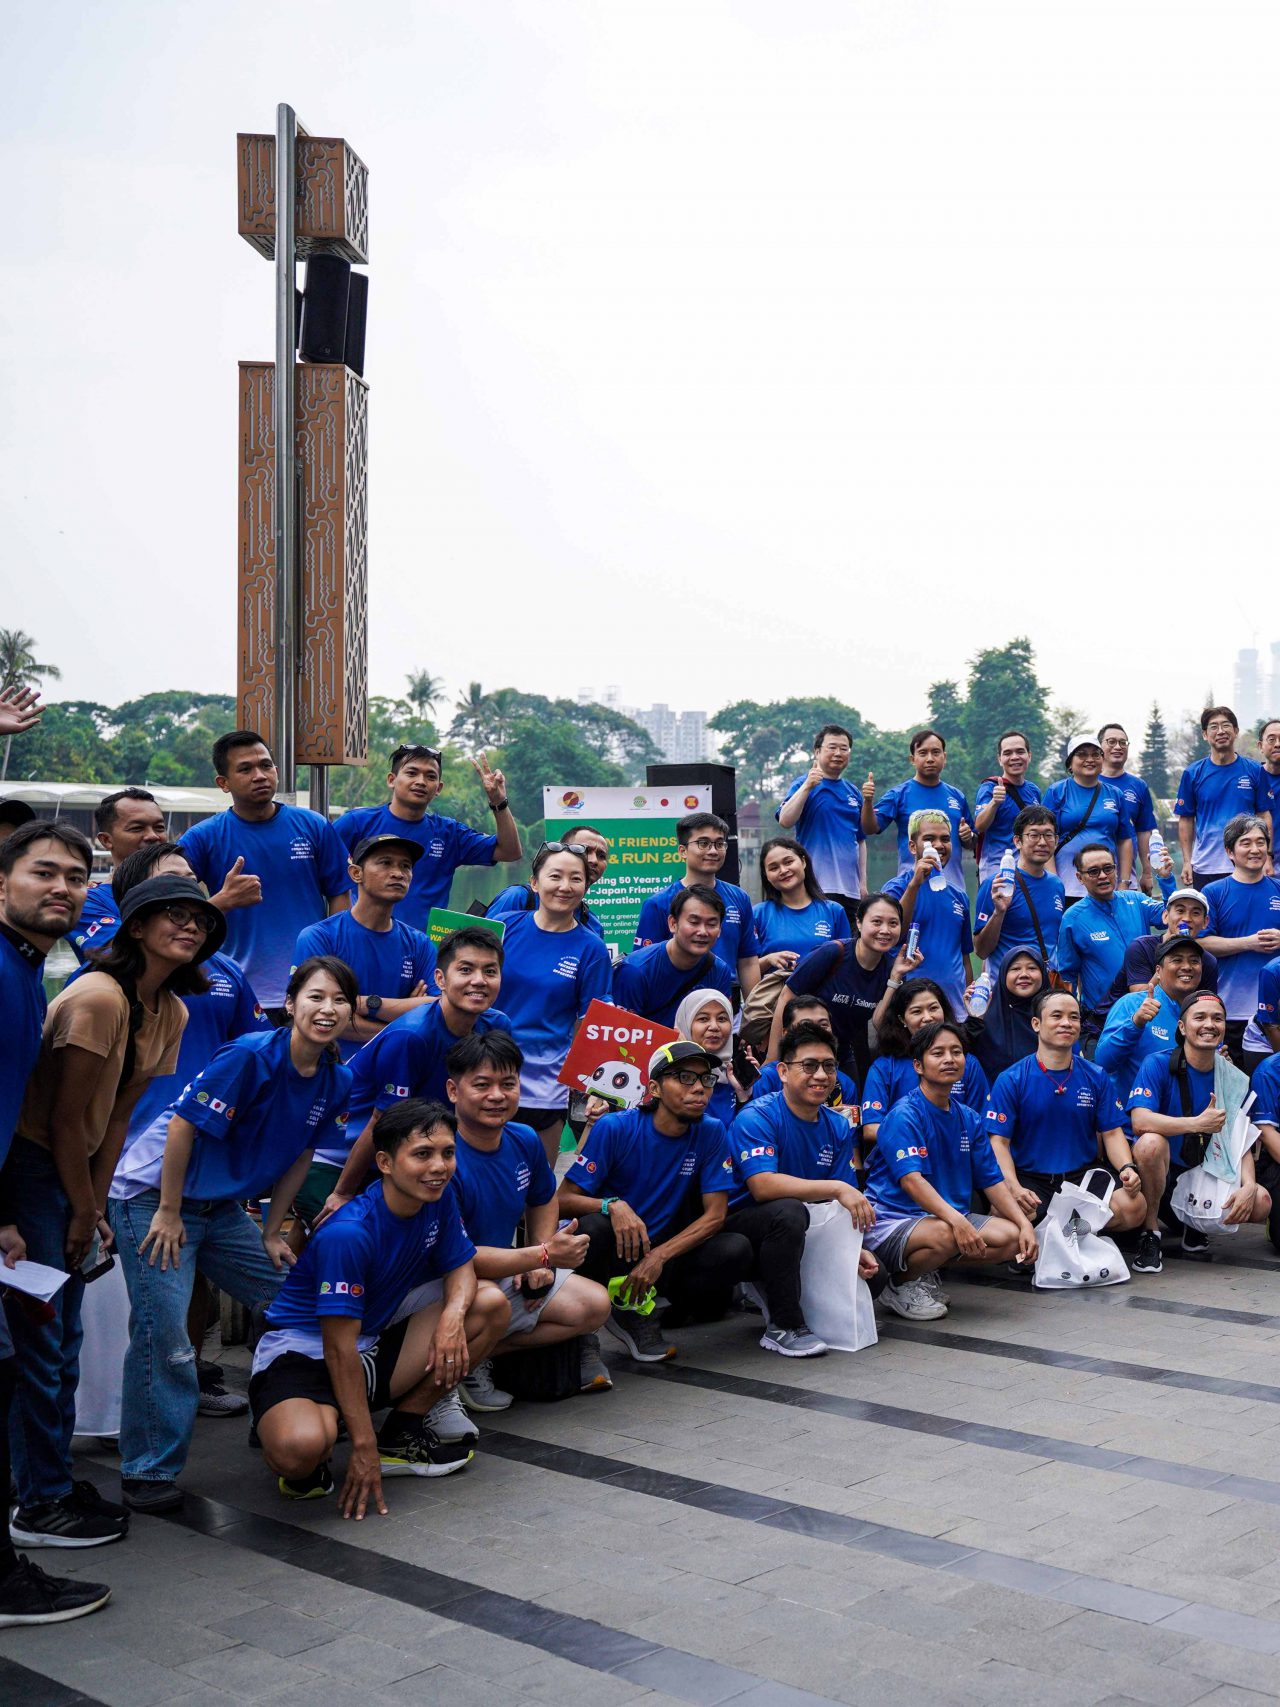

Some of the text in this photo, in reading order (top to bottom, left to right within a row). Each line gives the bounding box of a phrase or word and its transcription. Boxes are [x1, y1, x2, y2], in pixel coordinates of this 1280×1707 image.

[619, 837, 678, 847] FRIENDS
[608, 852, 686, 864] & RUN 20
[633, 876, 660, 884] Years
[662, 875, 673, 883] of
[430, 934, 446, 942] WA
[855, 999, 877, 1009] Salonp
[586, 1024, 653, 1046] STOP!
